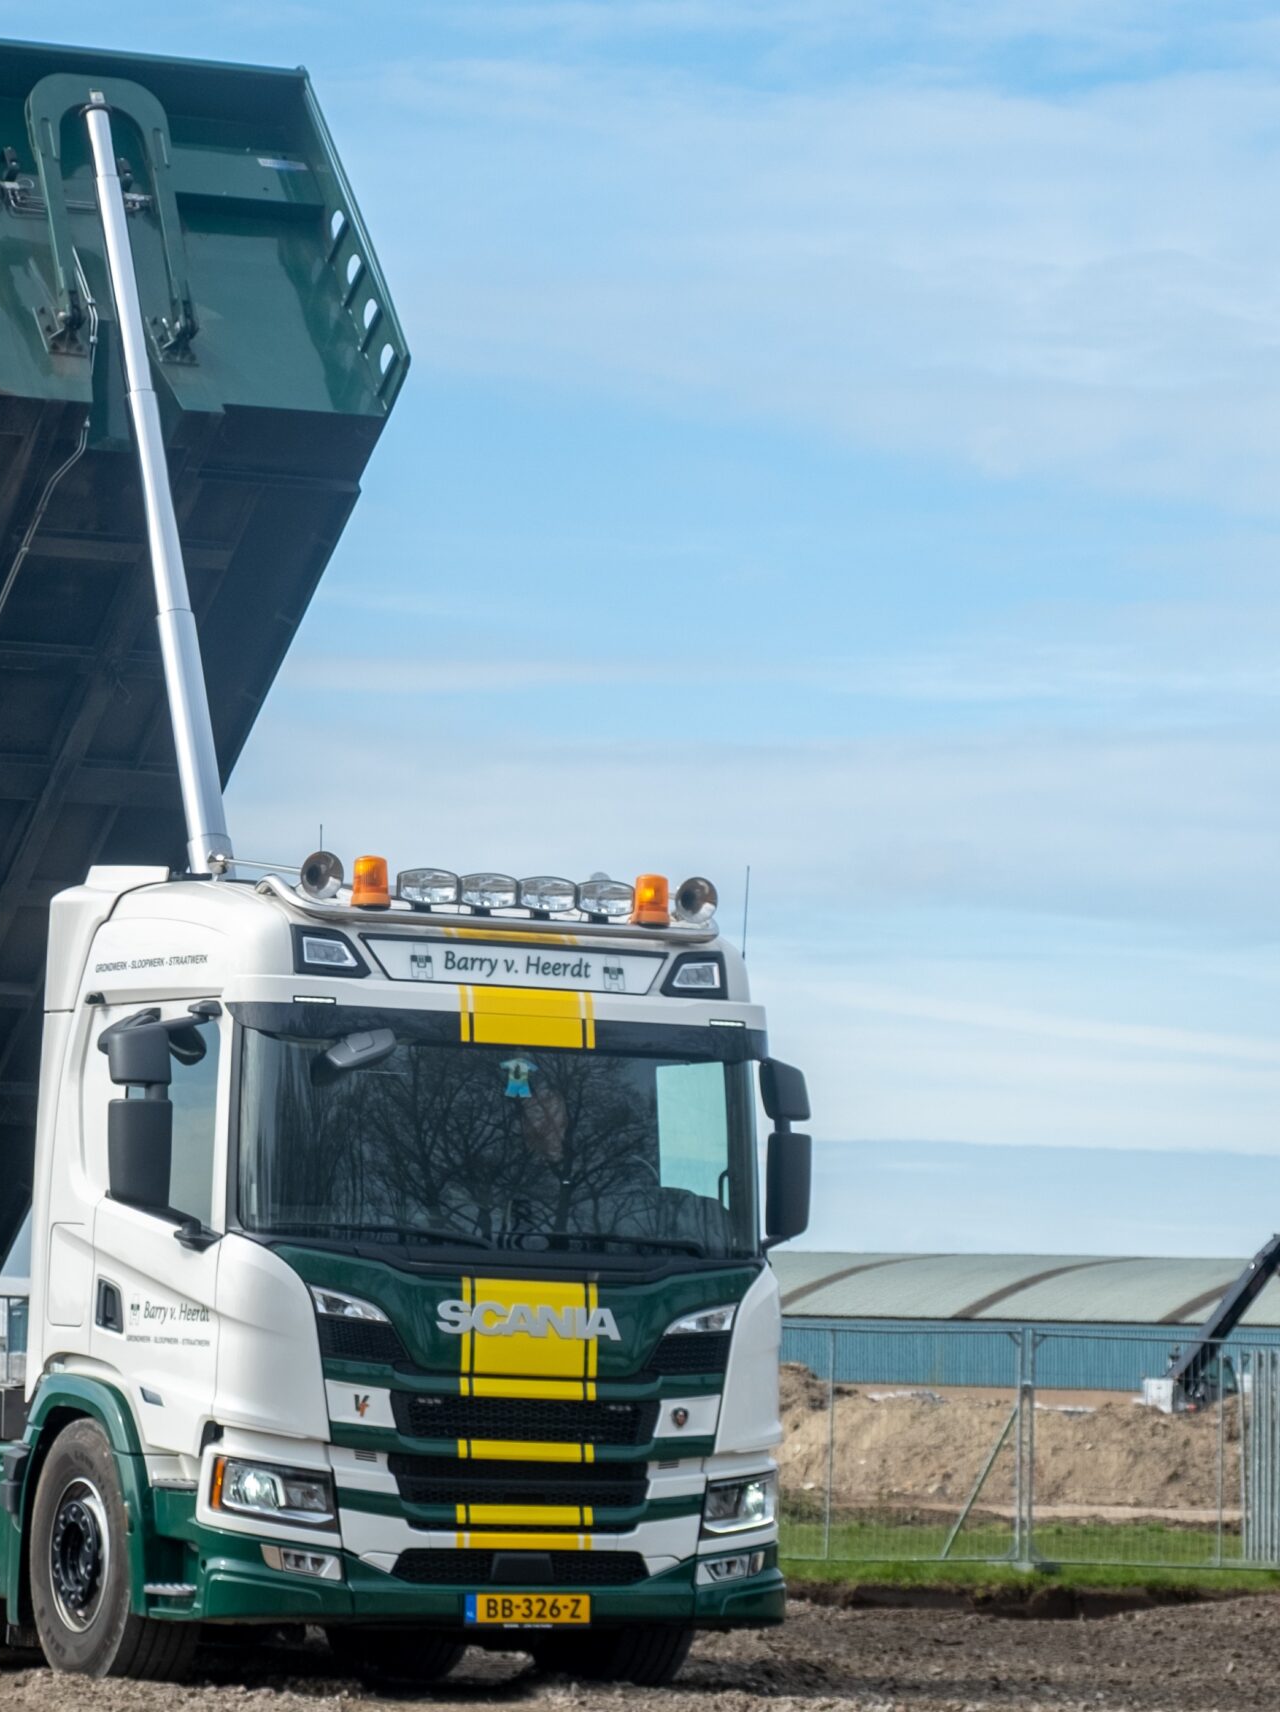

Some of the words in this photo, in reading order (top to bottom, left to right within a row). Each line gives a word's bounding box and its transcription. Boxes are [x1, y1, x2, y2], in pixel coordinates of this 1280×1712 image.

[131, 957, 166, 969] SLOOPWERK
[169, 954, 209, 966] STRAATWERK
[444, 950, 498, 977] Barry
[503, 958, 519, 974] v.
[525, 955, 591, 978] Heerdt
[144, 1300, 168, 1325] Barry
[170, 1307, 177, 1320] v.
[179, 1303, 209, 1322] Heerdt
[435, 1299, 622, 1341] SCANIA
[486, 1598, 582, 1619] BB-326-Z
